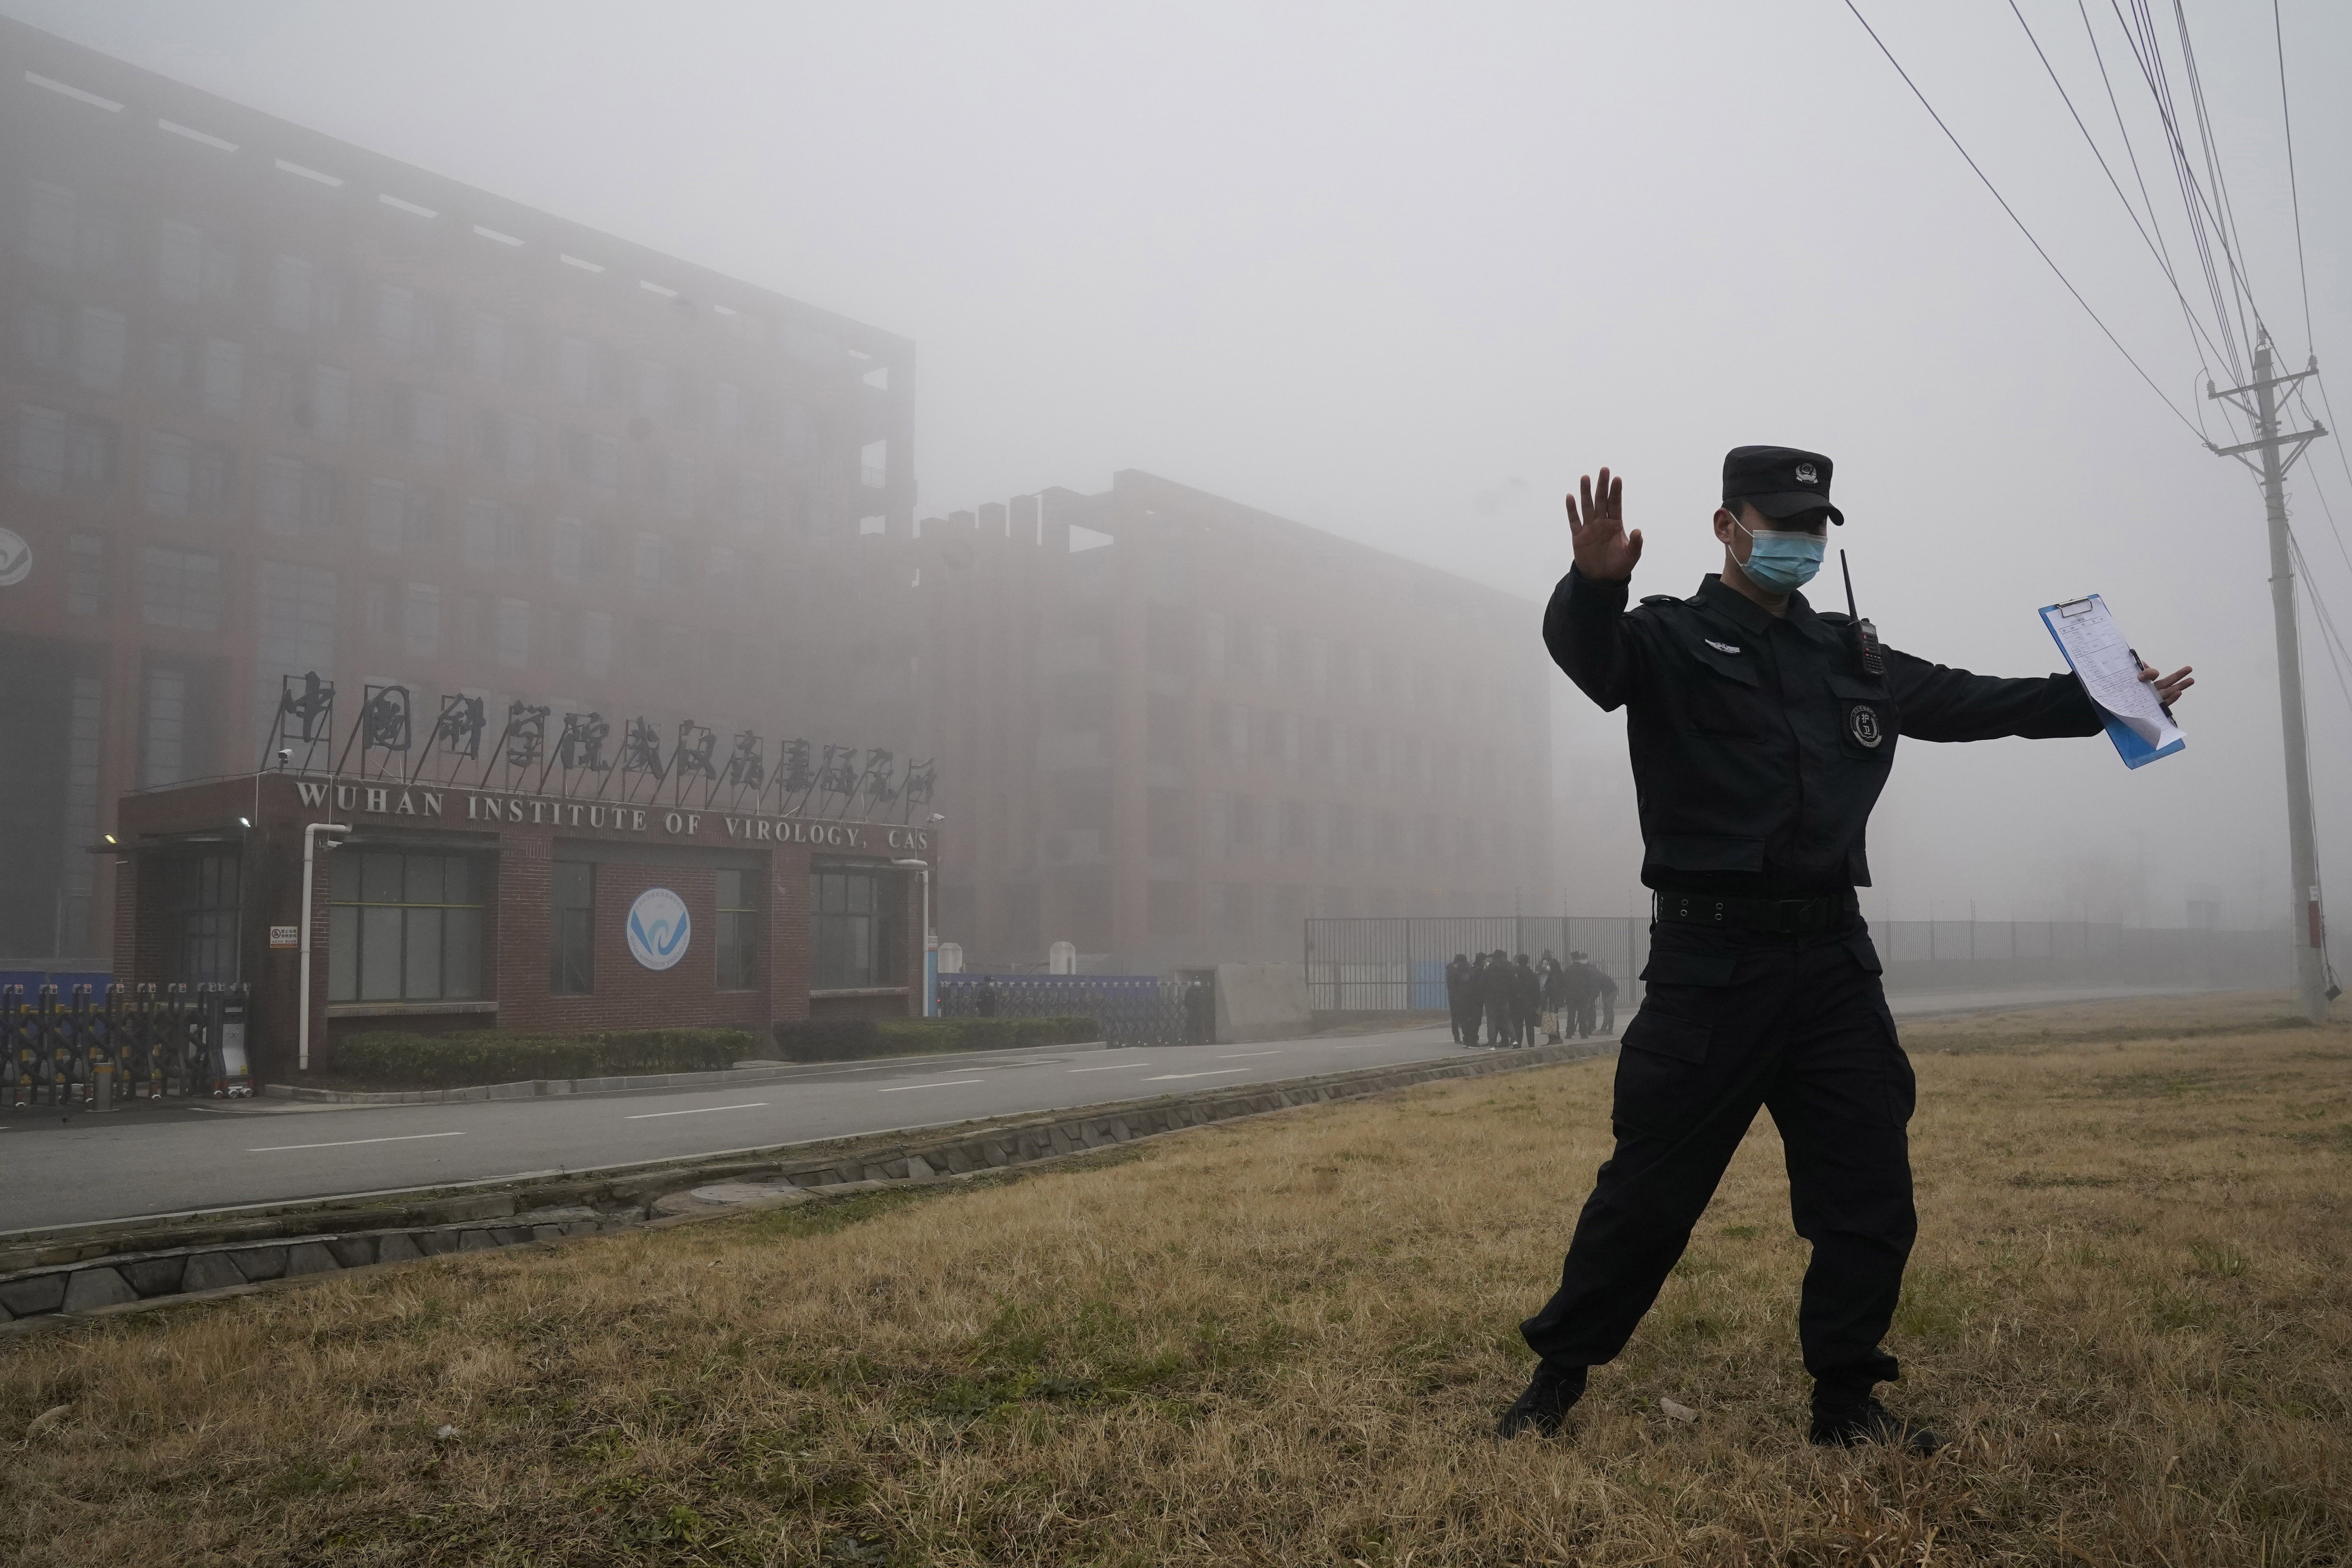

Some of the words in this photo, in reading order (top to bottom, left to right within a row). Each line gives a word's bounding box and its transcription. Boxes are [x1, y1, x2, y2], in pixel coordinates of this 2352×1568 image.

[1861, 713, 1871, 734] 护卫
[296, 781, 444, 817] WUHAN
[466, 796, 646, 832] INSTITUTE
[665, 812, 701, 835] OF
[888, 830, 928, 850] CAS
